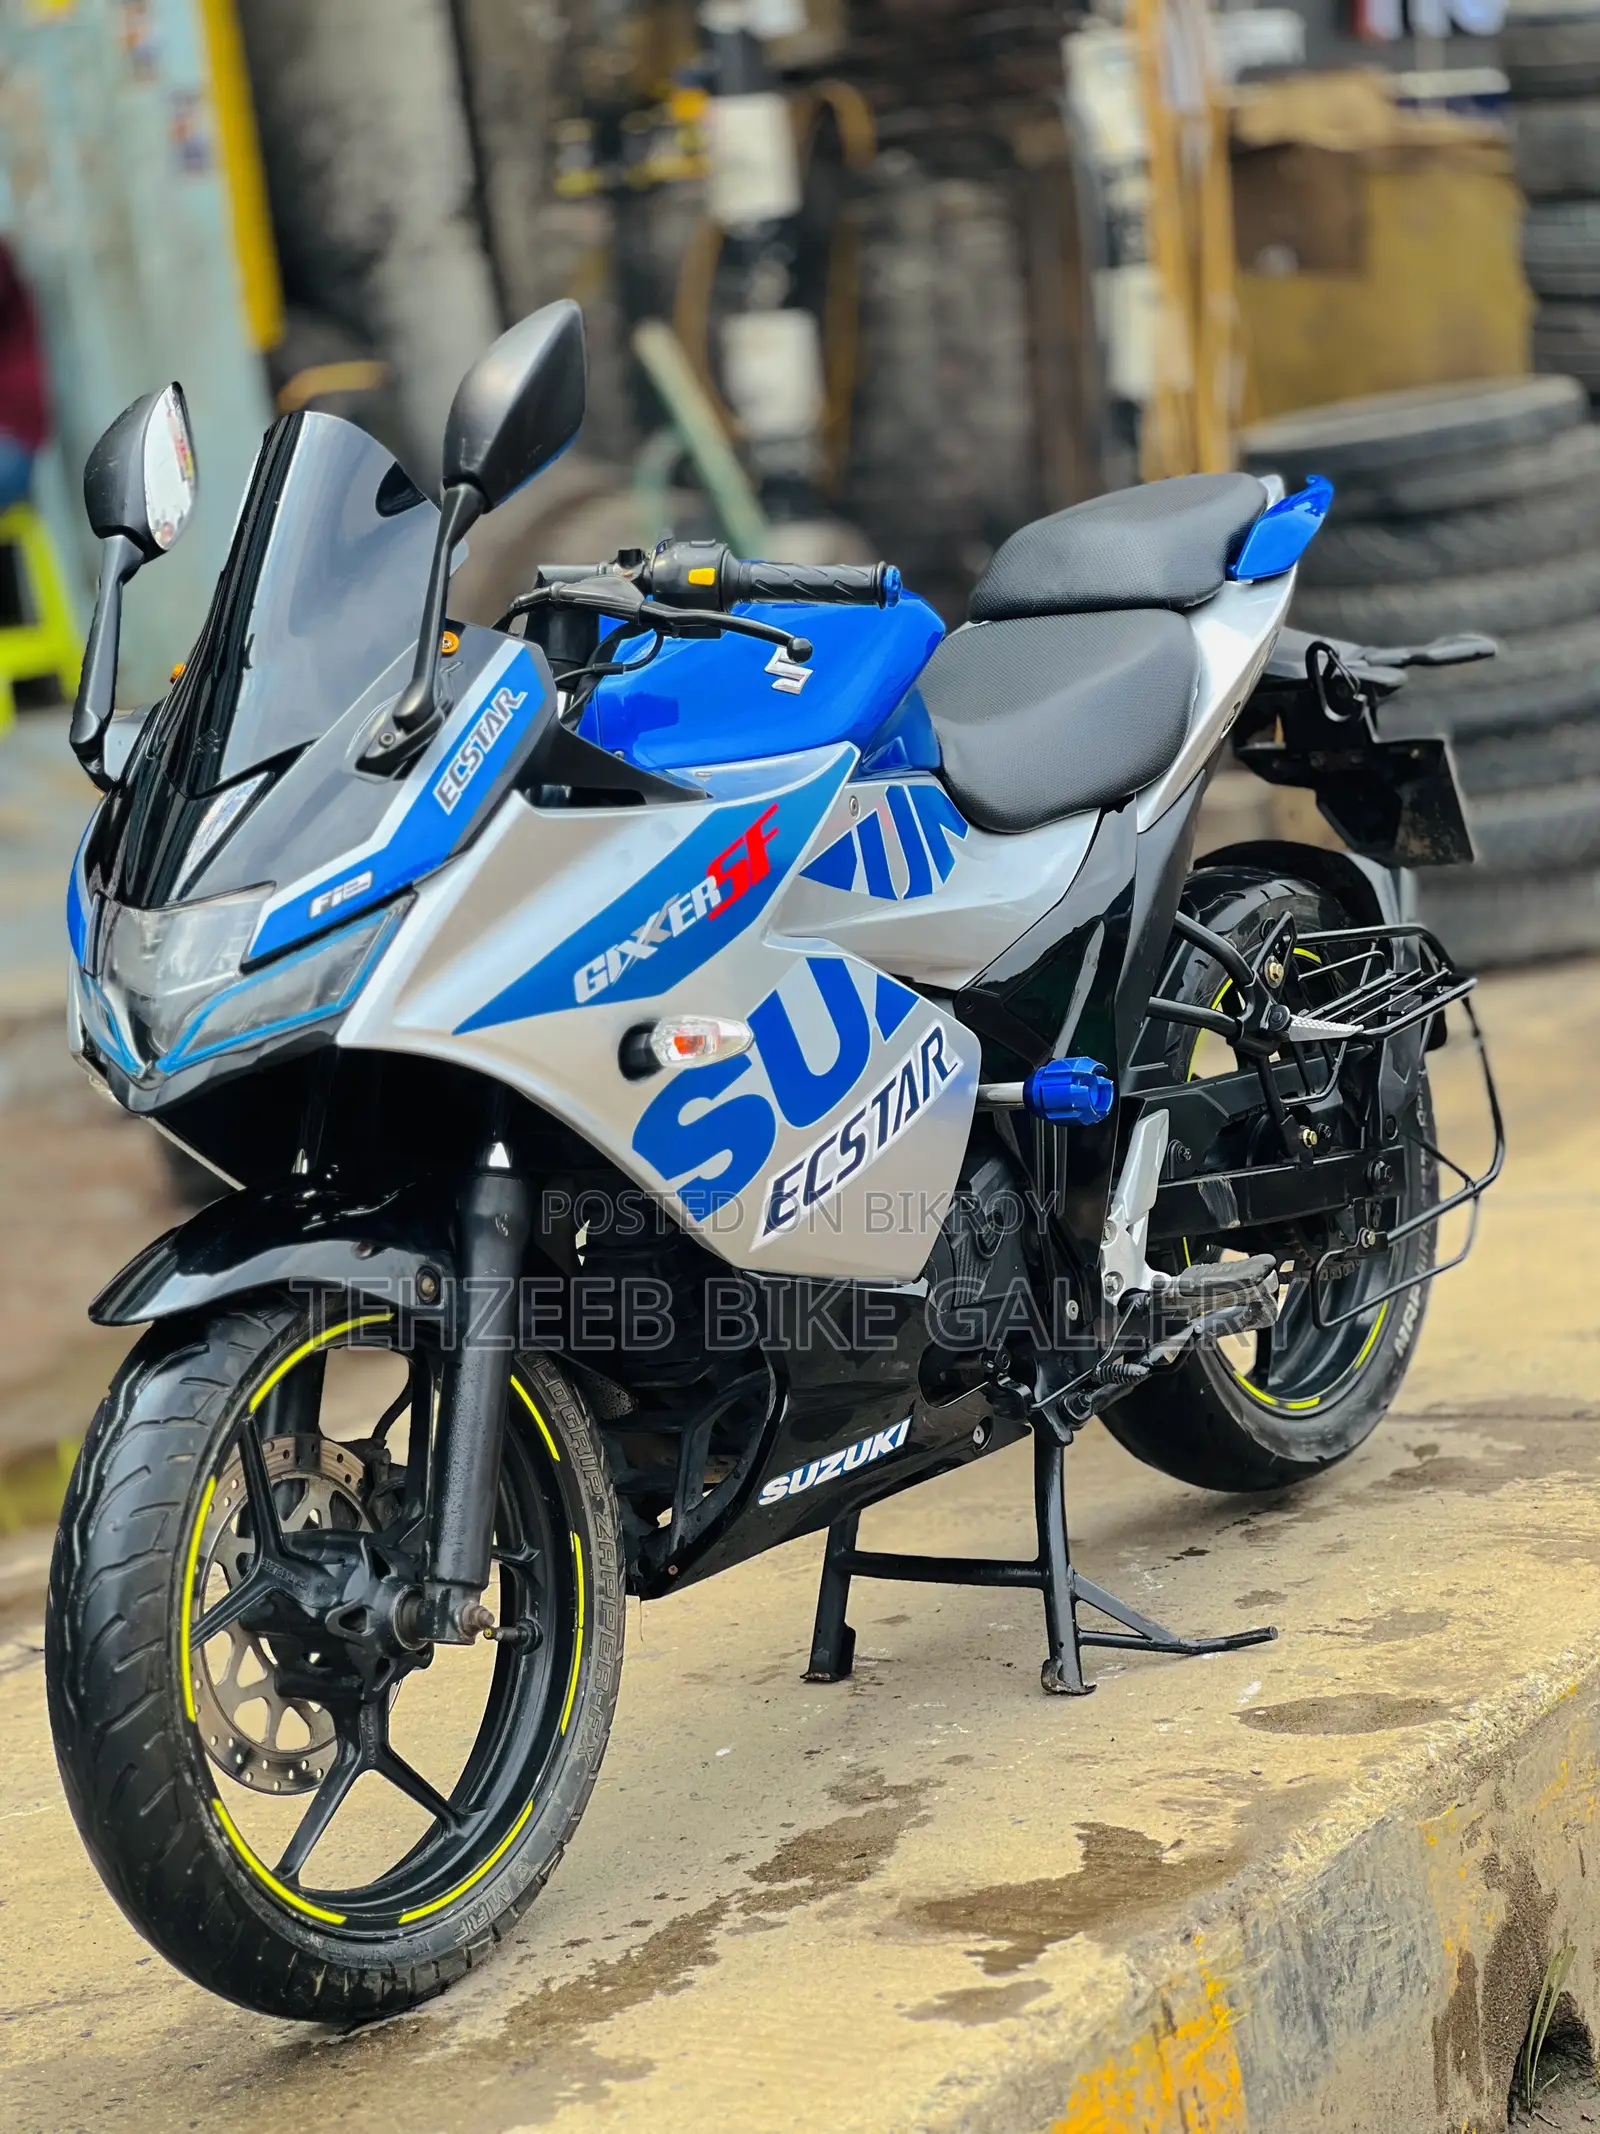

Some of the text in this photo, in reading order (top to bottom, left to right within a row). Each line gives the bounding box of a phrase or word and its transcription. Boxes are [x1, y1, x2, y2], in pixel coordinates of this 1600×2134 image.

[432, 687, 528, 815] ECSTAR
[706, 802, 779, 921] SF
[758, 1022, 961, 1240] ECSTAR
[758, 1418, 913, 1506] SUZUKI
[454, 1876, 514, 1942] MRF
